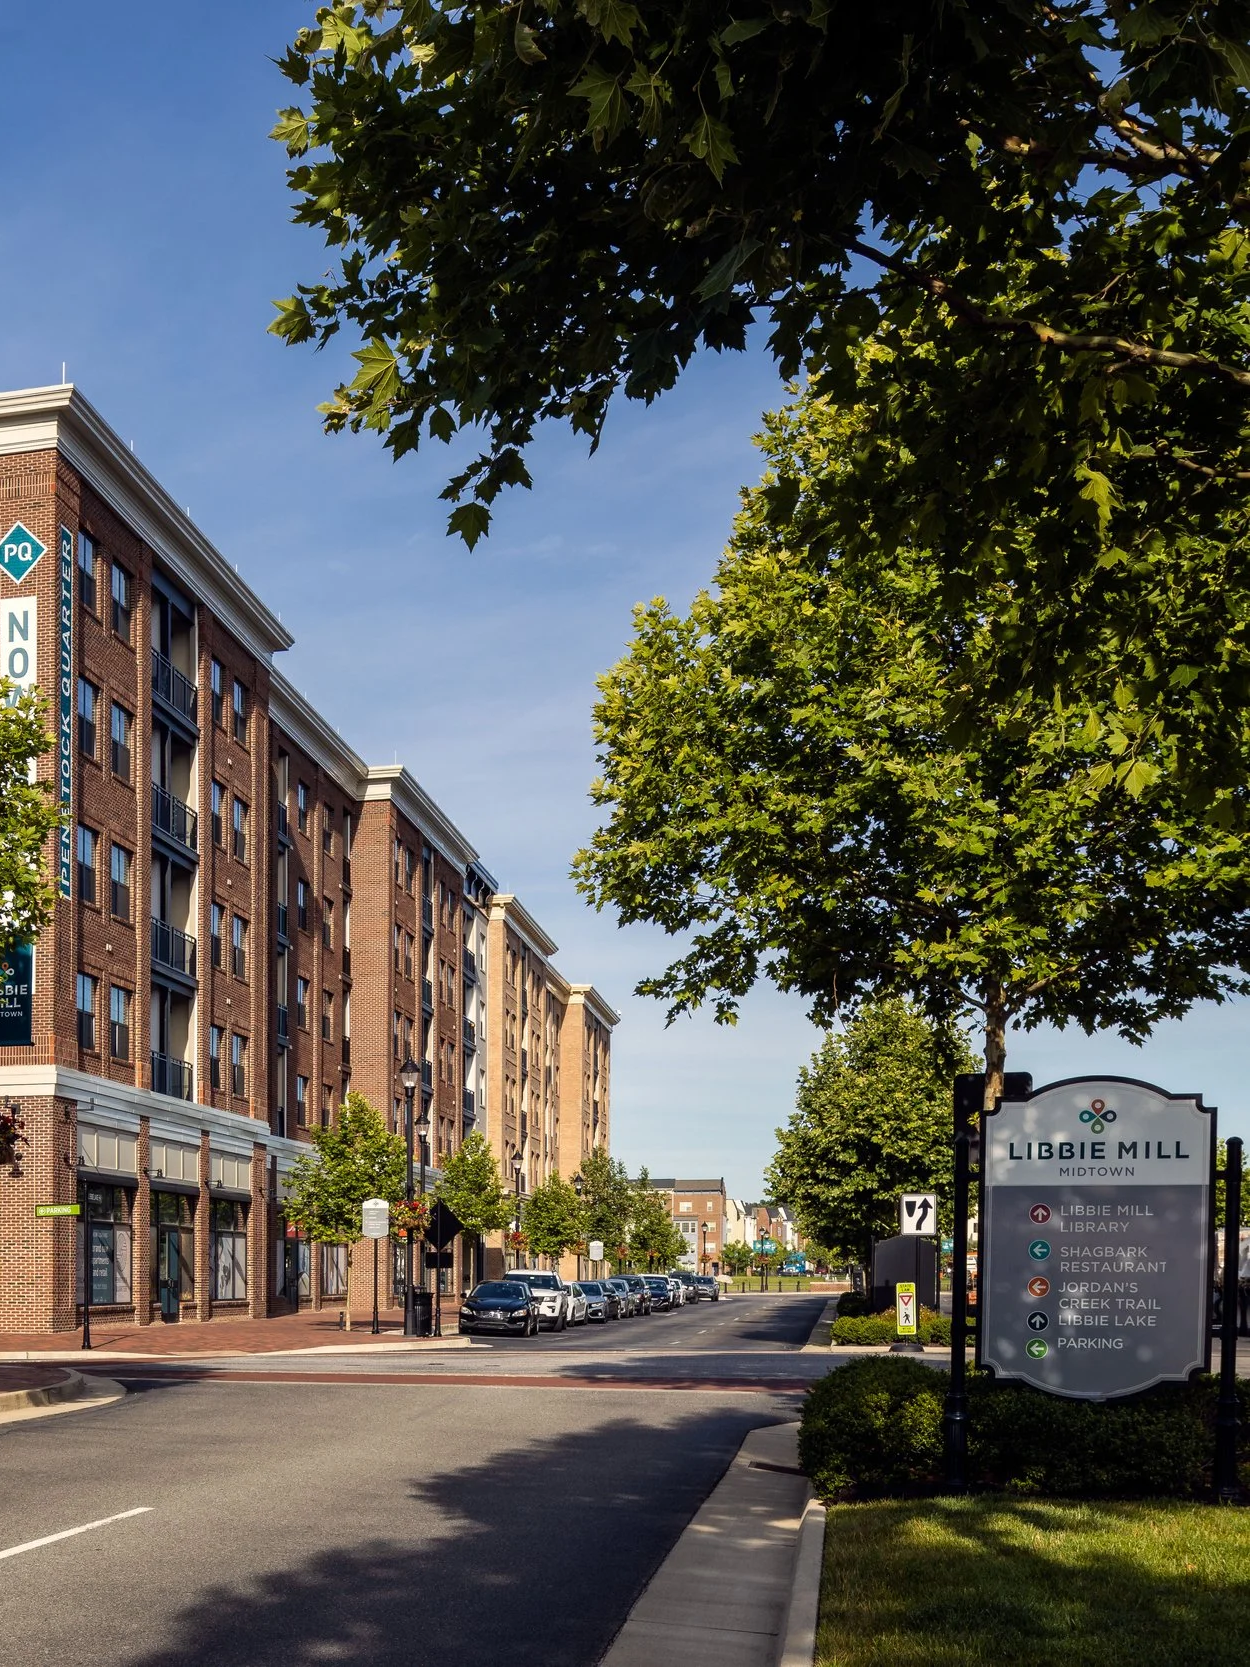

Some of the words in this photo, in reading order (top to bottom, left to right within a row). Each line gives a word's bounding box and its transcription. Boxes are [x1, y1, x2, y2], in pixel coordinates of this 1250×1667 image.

[4, 541, 33, 563] PQ
[61, 541, 71, 697] QUARTER
[1008, 1141, 1106, 1160] LIBBIE
[1118, 1141, 1190, 1160] MILL
[1059, 1167, 1135, 1177] MIDTOWN
[46, 1206, 71, 1214] PARKING
[1060, 1205, 1111, 1216] LIBBIE
[1117, 1205, 1154, 1216] MILL
[1060, 1221, 1130, 1233] LIBRARY
[1060, 1246, 1148, 1258] SHAGBARK
[1060, 1261, 1167, 1273] RESTAURANT
[1058, 1282, 1138, 1293] JORDAN'S
[1058, 1298, 1110, 1310] CREEK
[1116, 1298, 1161, 1310] TRAIL
[1058, 1314, 1109, 1326] LIBBIE
[1114, 1315, 1157, 1327] LAKE
[1057, 1337, 1124, 1349] PARKING
